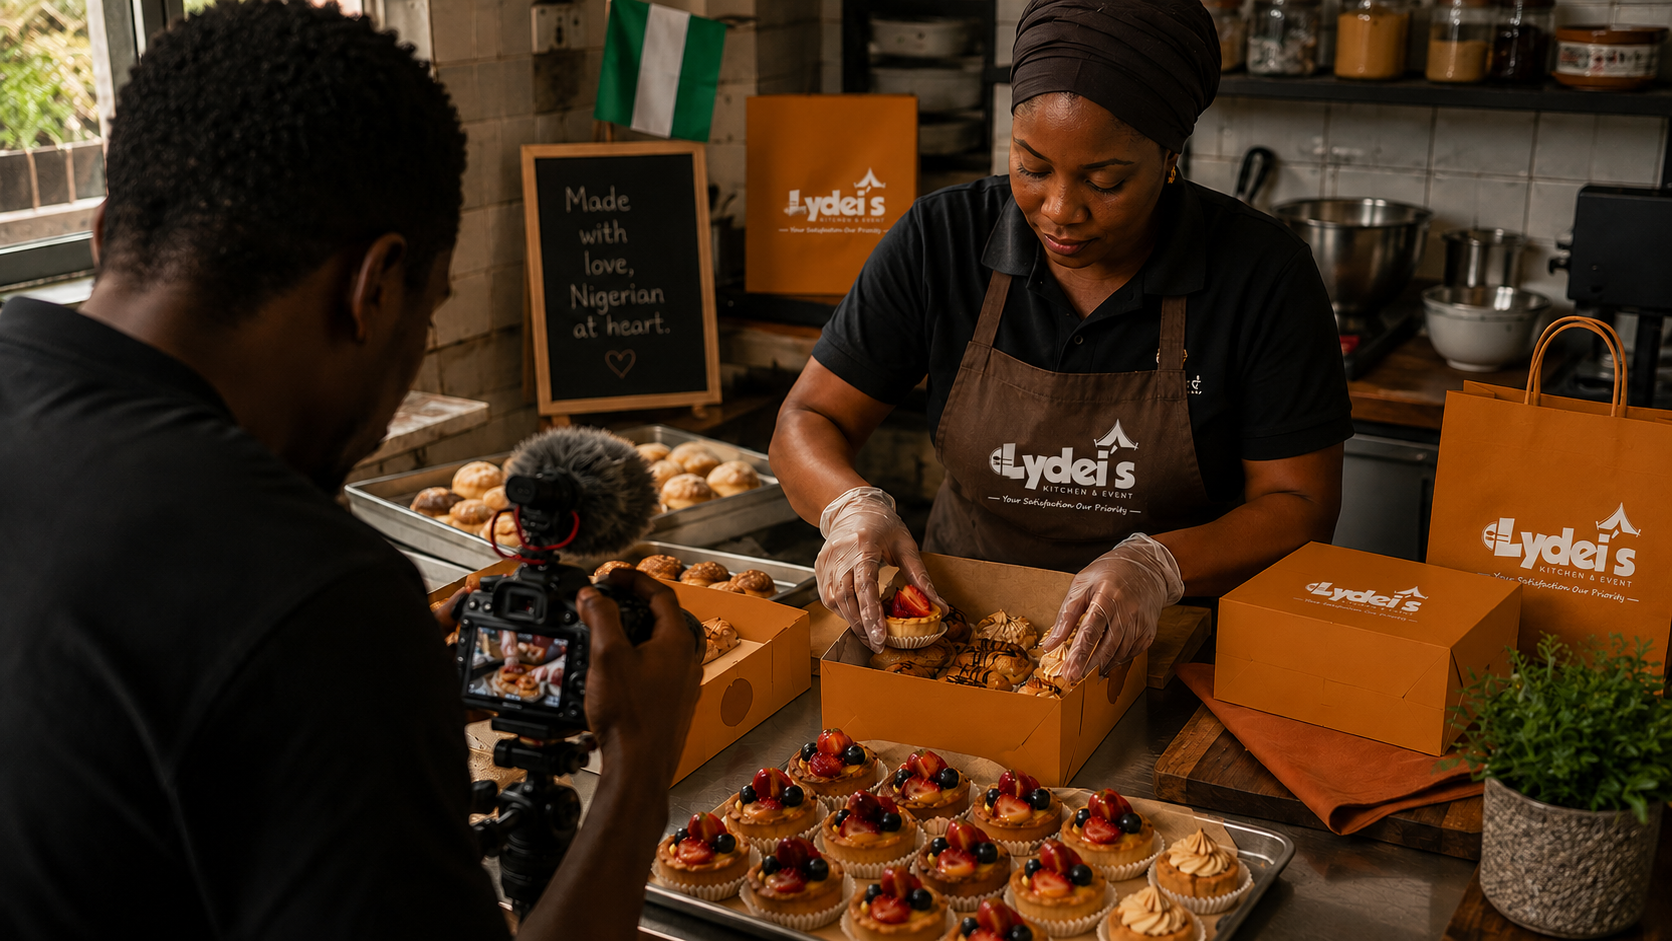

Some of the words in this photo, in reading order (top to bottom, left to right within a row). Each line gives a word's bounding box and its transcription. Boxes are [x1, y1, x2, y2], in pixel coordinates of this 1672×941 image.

[565, 185, 631, 213] Made
[579, 219, 628, 245] with
[584, 250, 634, 278] love,
[569, 282, 665, 316] Nigerian
[573, 315, 598, 339] at
[606, 311, 671, 337] heart.
[1001, 443, 1136, 490] Lydei's
[1002, 495, 1021, 503] Your
[1023, 497, 1075, 509] Satisfaction
[1075, 502, 1092, 510] Our
[1094, 503, 1128, 515] Priority
[1043, 485, 1087, 496] KITCHEN
[1102, 490, 1134, 500] EVENT
[1494, 517, 1637, 577] Lydei's
[1518, 576, 1571, 592] Satisfaction
[1571, 585, 1589, 595] Our
[1591, 588, 1626, 603] Priority
[1539, 565, 1585, 579] KITCHEN
[1599, 575, 1633, 588] EVENT
